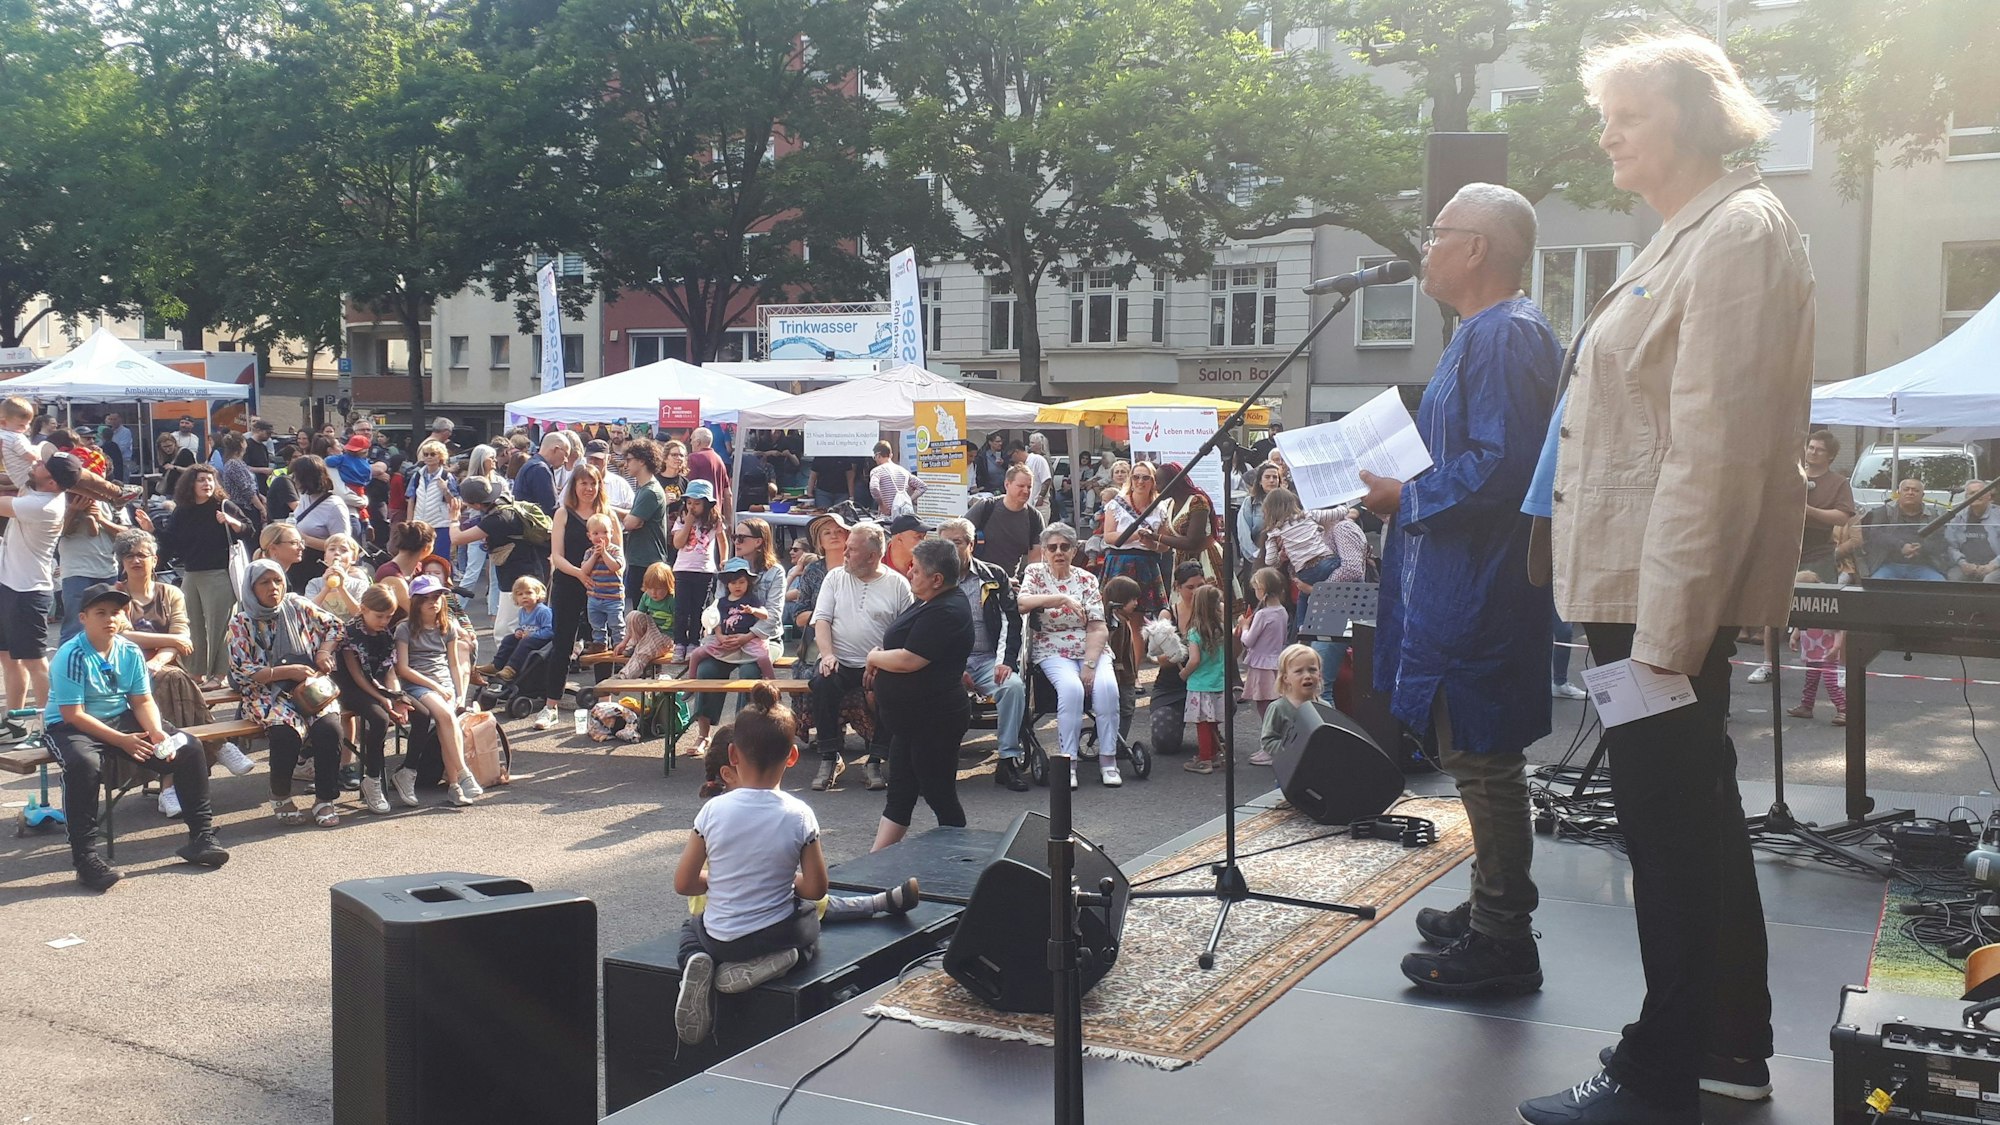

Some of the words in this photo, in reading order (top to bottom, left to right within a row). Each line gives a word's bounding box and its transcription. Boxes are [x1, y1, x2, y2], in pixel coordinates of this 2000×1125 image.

[779, 320, 858, 334] Trinkwasser
[1199, 367, 1242, 381] Salon
[167, 387, 193, 395] Kinder-
[195, 387, 208, 395] und
[1246, 412, 1263, 420] Köln
[1791, 596, 1839, 614] AMAHA
